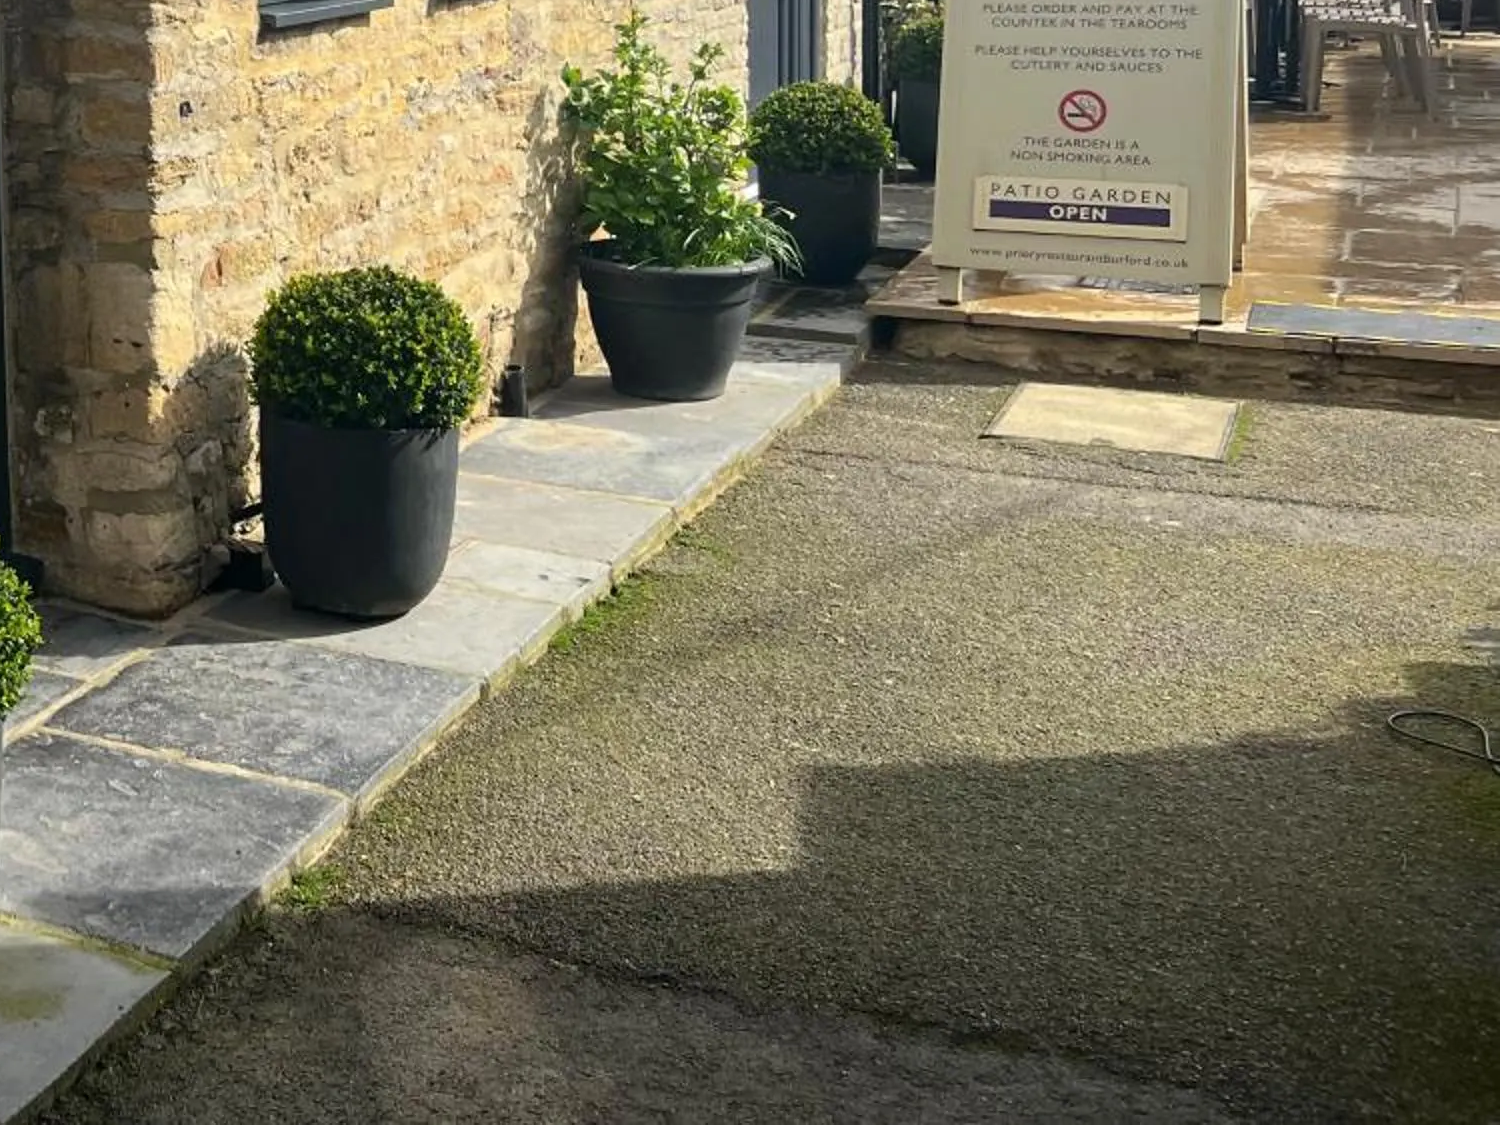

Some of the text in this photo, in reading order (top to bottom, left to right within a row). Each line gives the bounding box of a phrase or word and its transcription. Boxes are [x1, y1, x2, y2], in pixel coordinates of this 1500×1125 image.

[982, 3, 1200, 16] PLEASE ORDER AND PAY AT THE
[991, 18, 1188, 30] COUNTER IN THE TEAROOMS
[975, 44, 1204, 60] PLEASE HELP YOURSELVES TO THE
[1010, 59, 1164, 74] CUTLERY AND SAUCES
[1023, 137, 1140, 150] THE GARDEN IS A
[1012, 150, 1151, 166] NON SMOKING AREA
[990, 182, 1172, 205] PATIO GARDEN
[1048, 203, 1108, 222] OPEN
